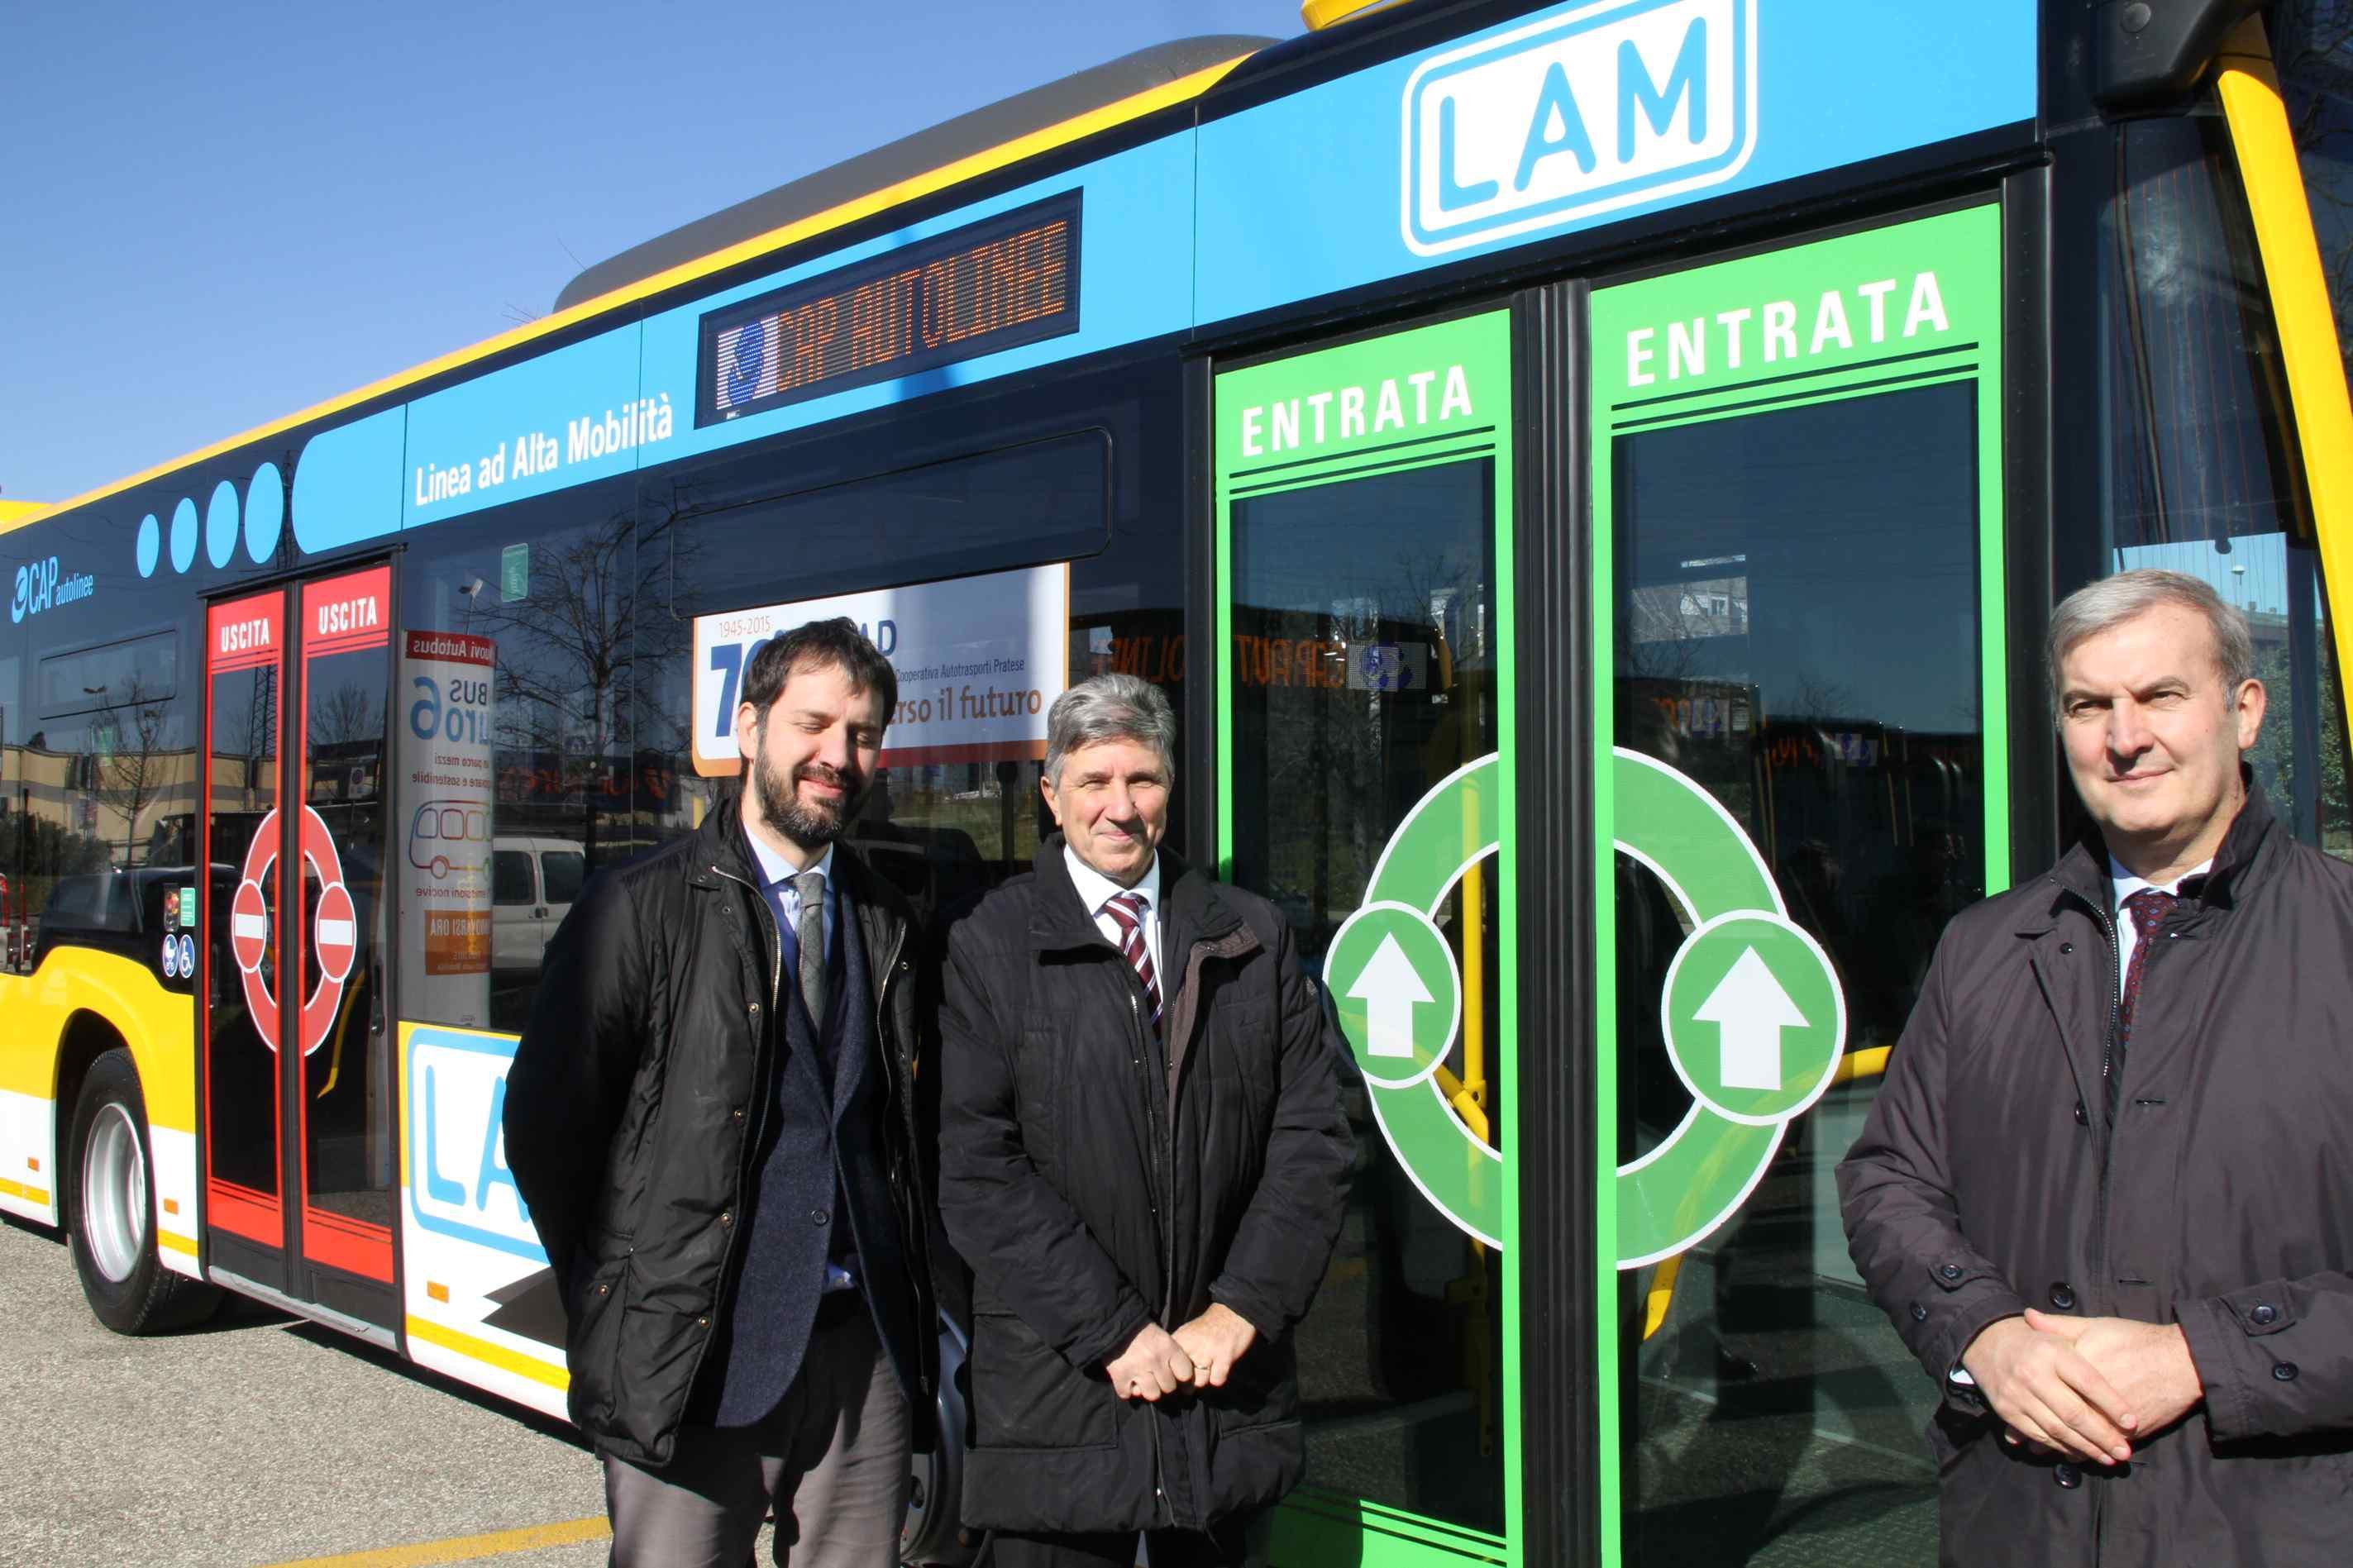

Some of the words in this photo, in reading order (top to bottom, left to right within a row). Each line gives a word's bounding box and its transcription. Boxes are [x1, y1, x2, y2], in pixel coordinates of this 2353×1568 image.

[1439, 16, 1707, 212] LAM
[778, 297, 837, 392] CAP
[852, 219, 1067, 370] AUTOLINEE
[1626, 269, 1950, 388] ENTRATA
[1242, 364, 1473, 457] ENTRATA
[416, 463, 470, 507] Linea
[478, 442, 505, 489] ad
[512, 432, 559, 479] Alta
[568, 392, 673, 465] Mobilità
[29, 555, 58, 615] CAP
[55, 571, 93, 606] autolinee
[318, 595, 378, 635] USCITA
[221, 617, 270, 652] USCITA
[718, 615, 771, 637] 1945-2015
[895, 665, 939, 684] Cooperativa
[940, 660, 992, 679] Autotrasporti
[993, 658, 1024, 673] Pratese
[939, 686, 952, 721] il
[959, 684, 1043, 719] futuro
[425, 1064, 530, 1223] LA
